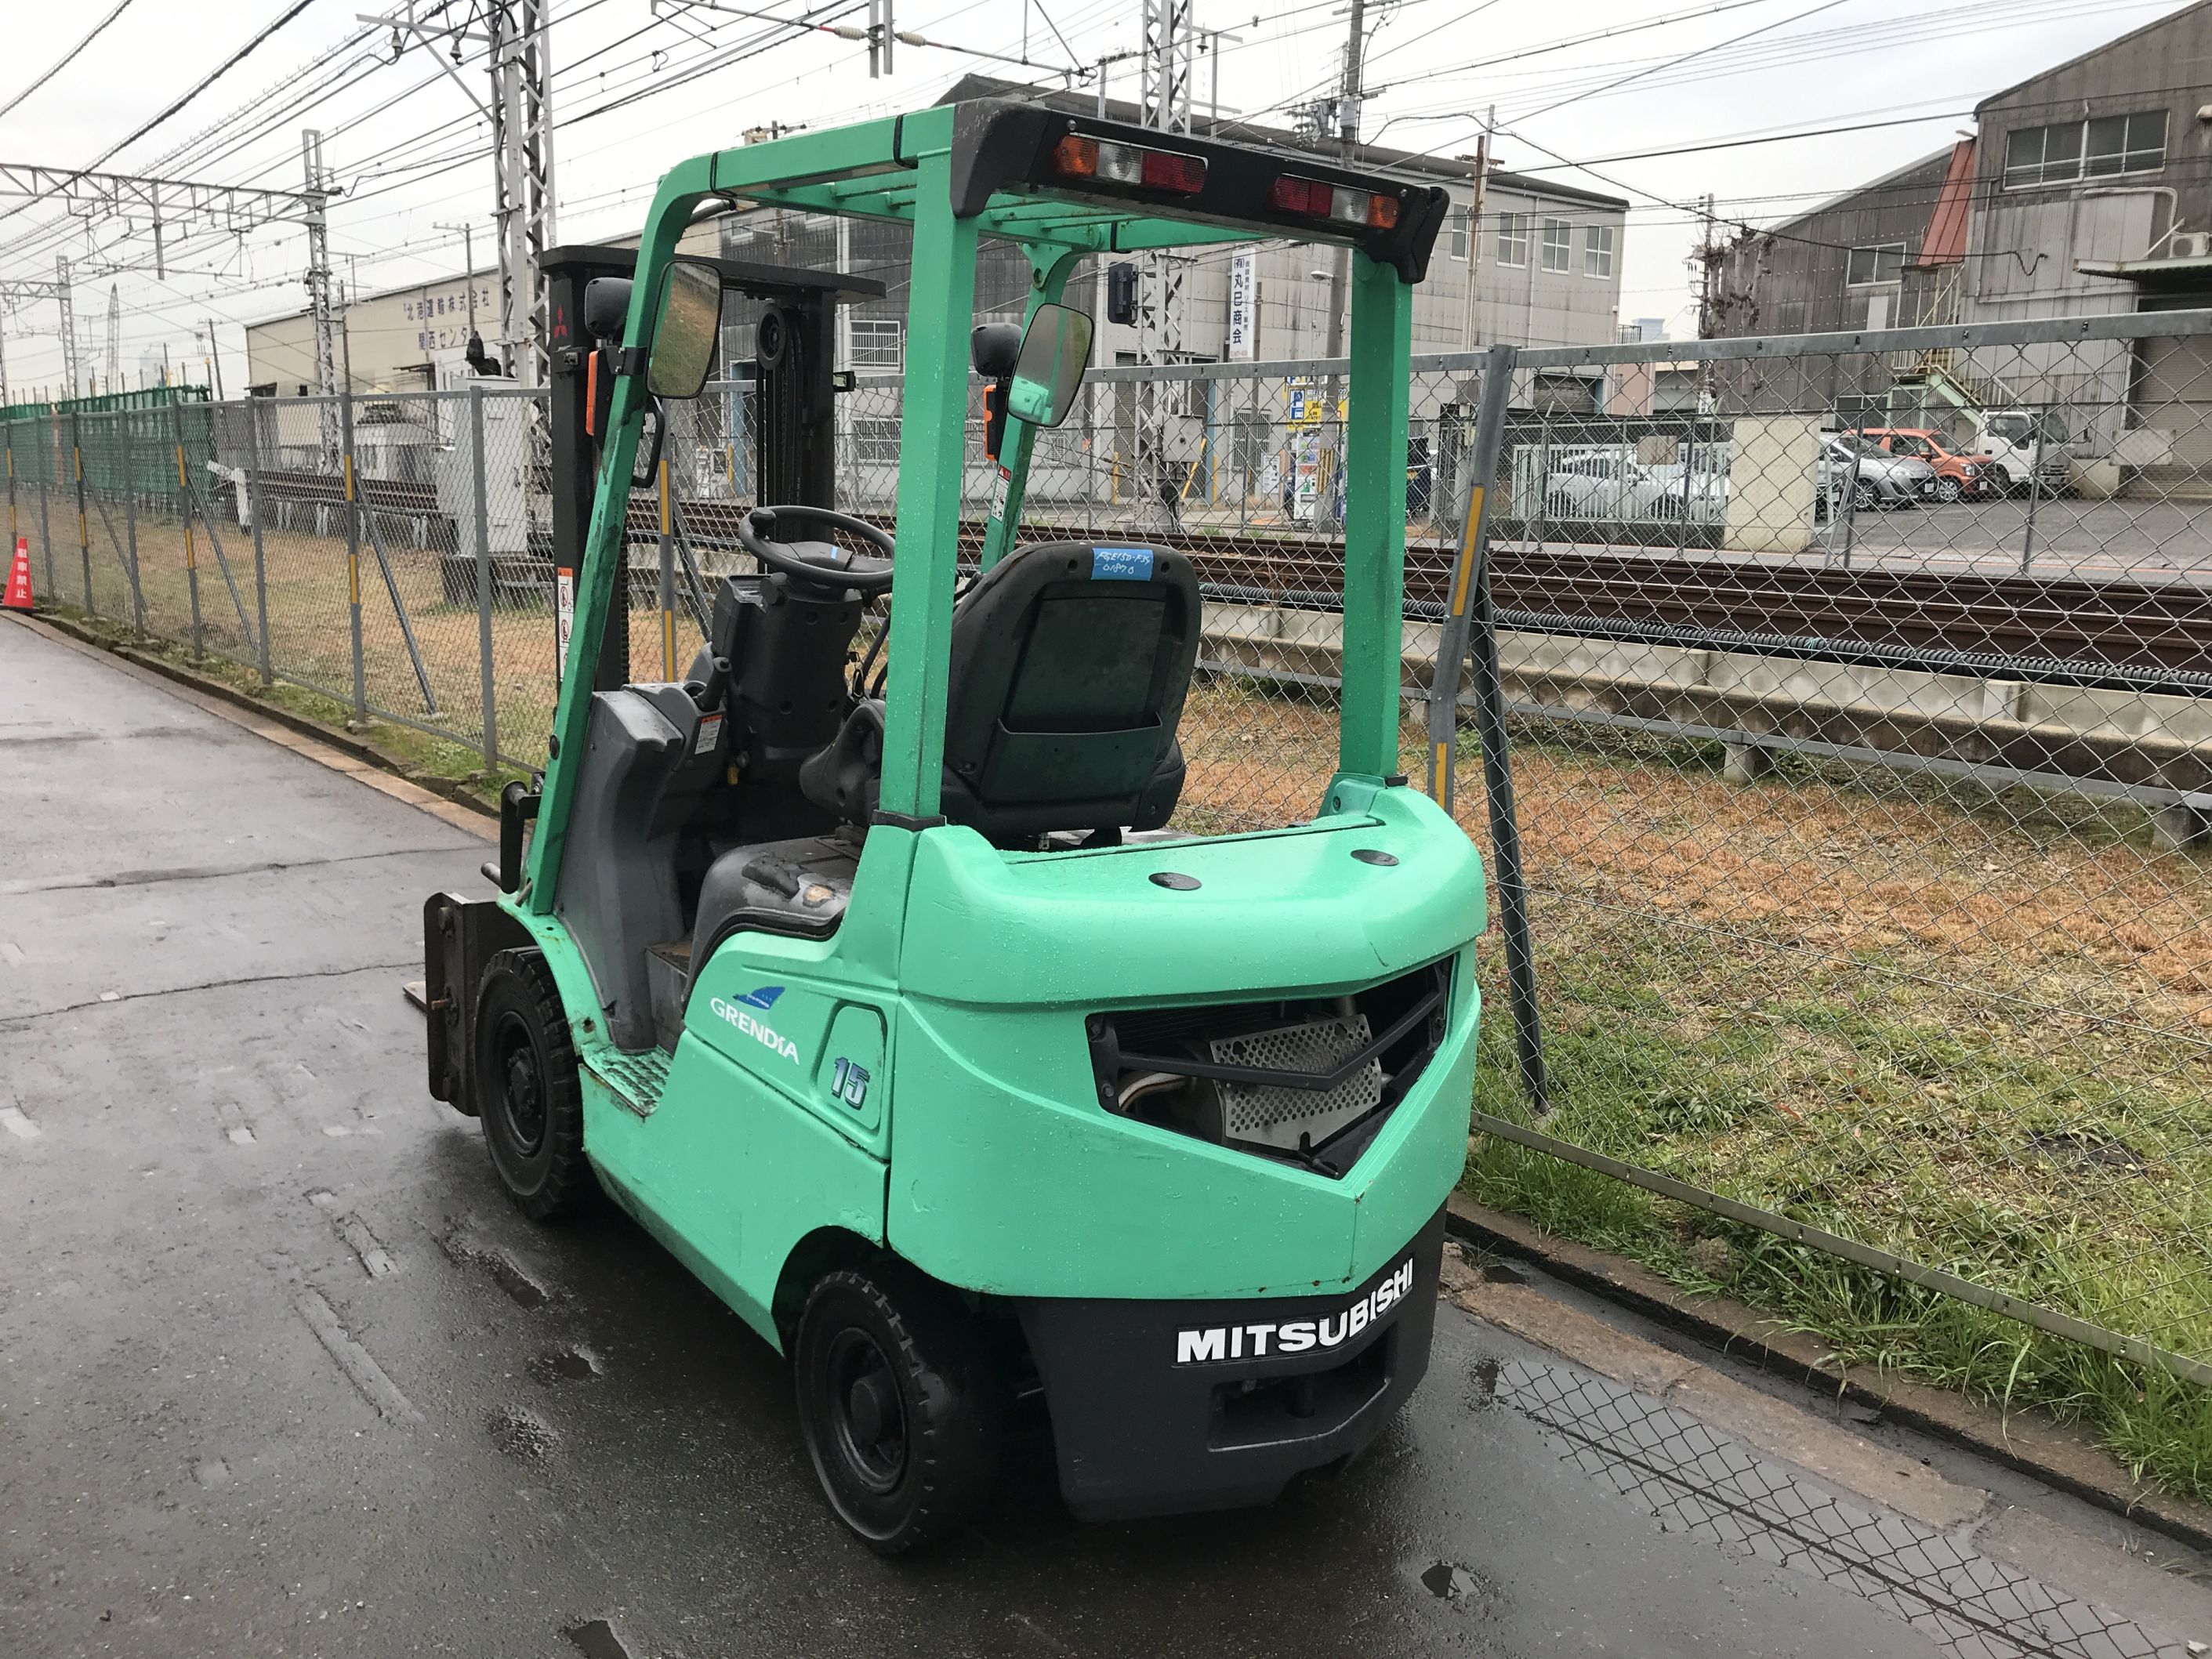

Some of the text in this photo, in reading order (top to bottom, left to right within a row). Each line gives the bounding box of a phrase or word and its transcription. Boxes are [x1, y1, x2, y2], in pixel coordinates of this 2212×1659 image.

[418, 327, 477, 350] 関西センタ
[831, 1057, 870, 1110] 15
[1177, 1257, 1413, 1364] MITSUBISHI
